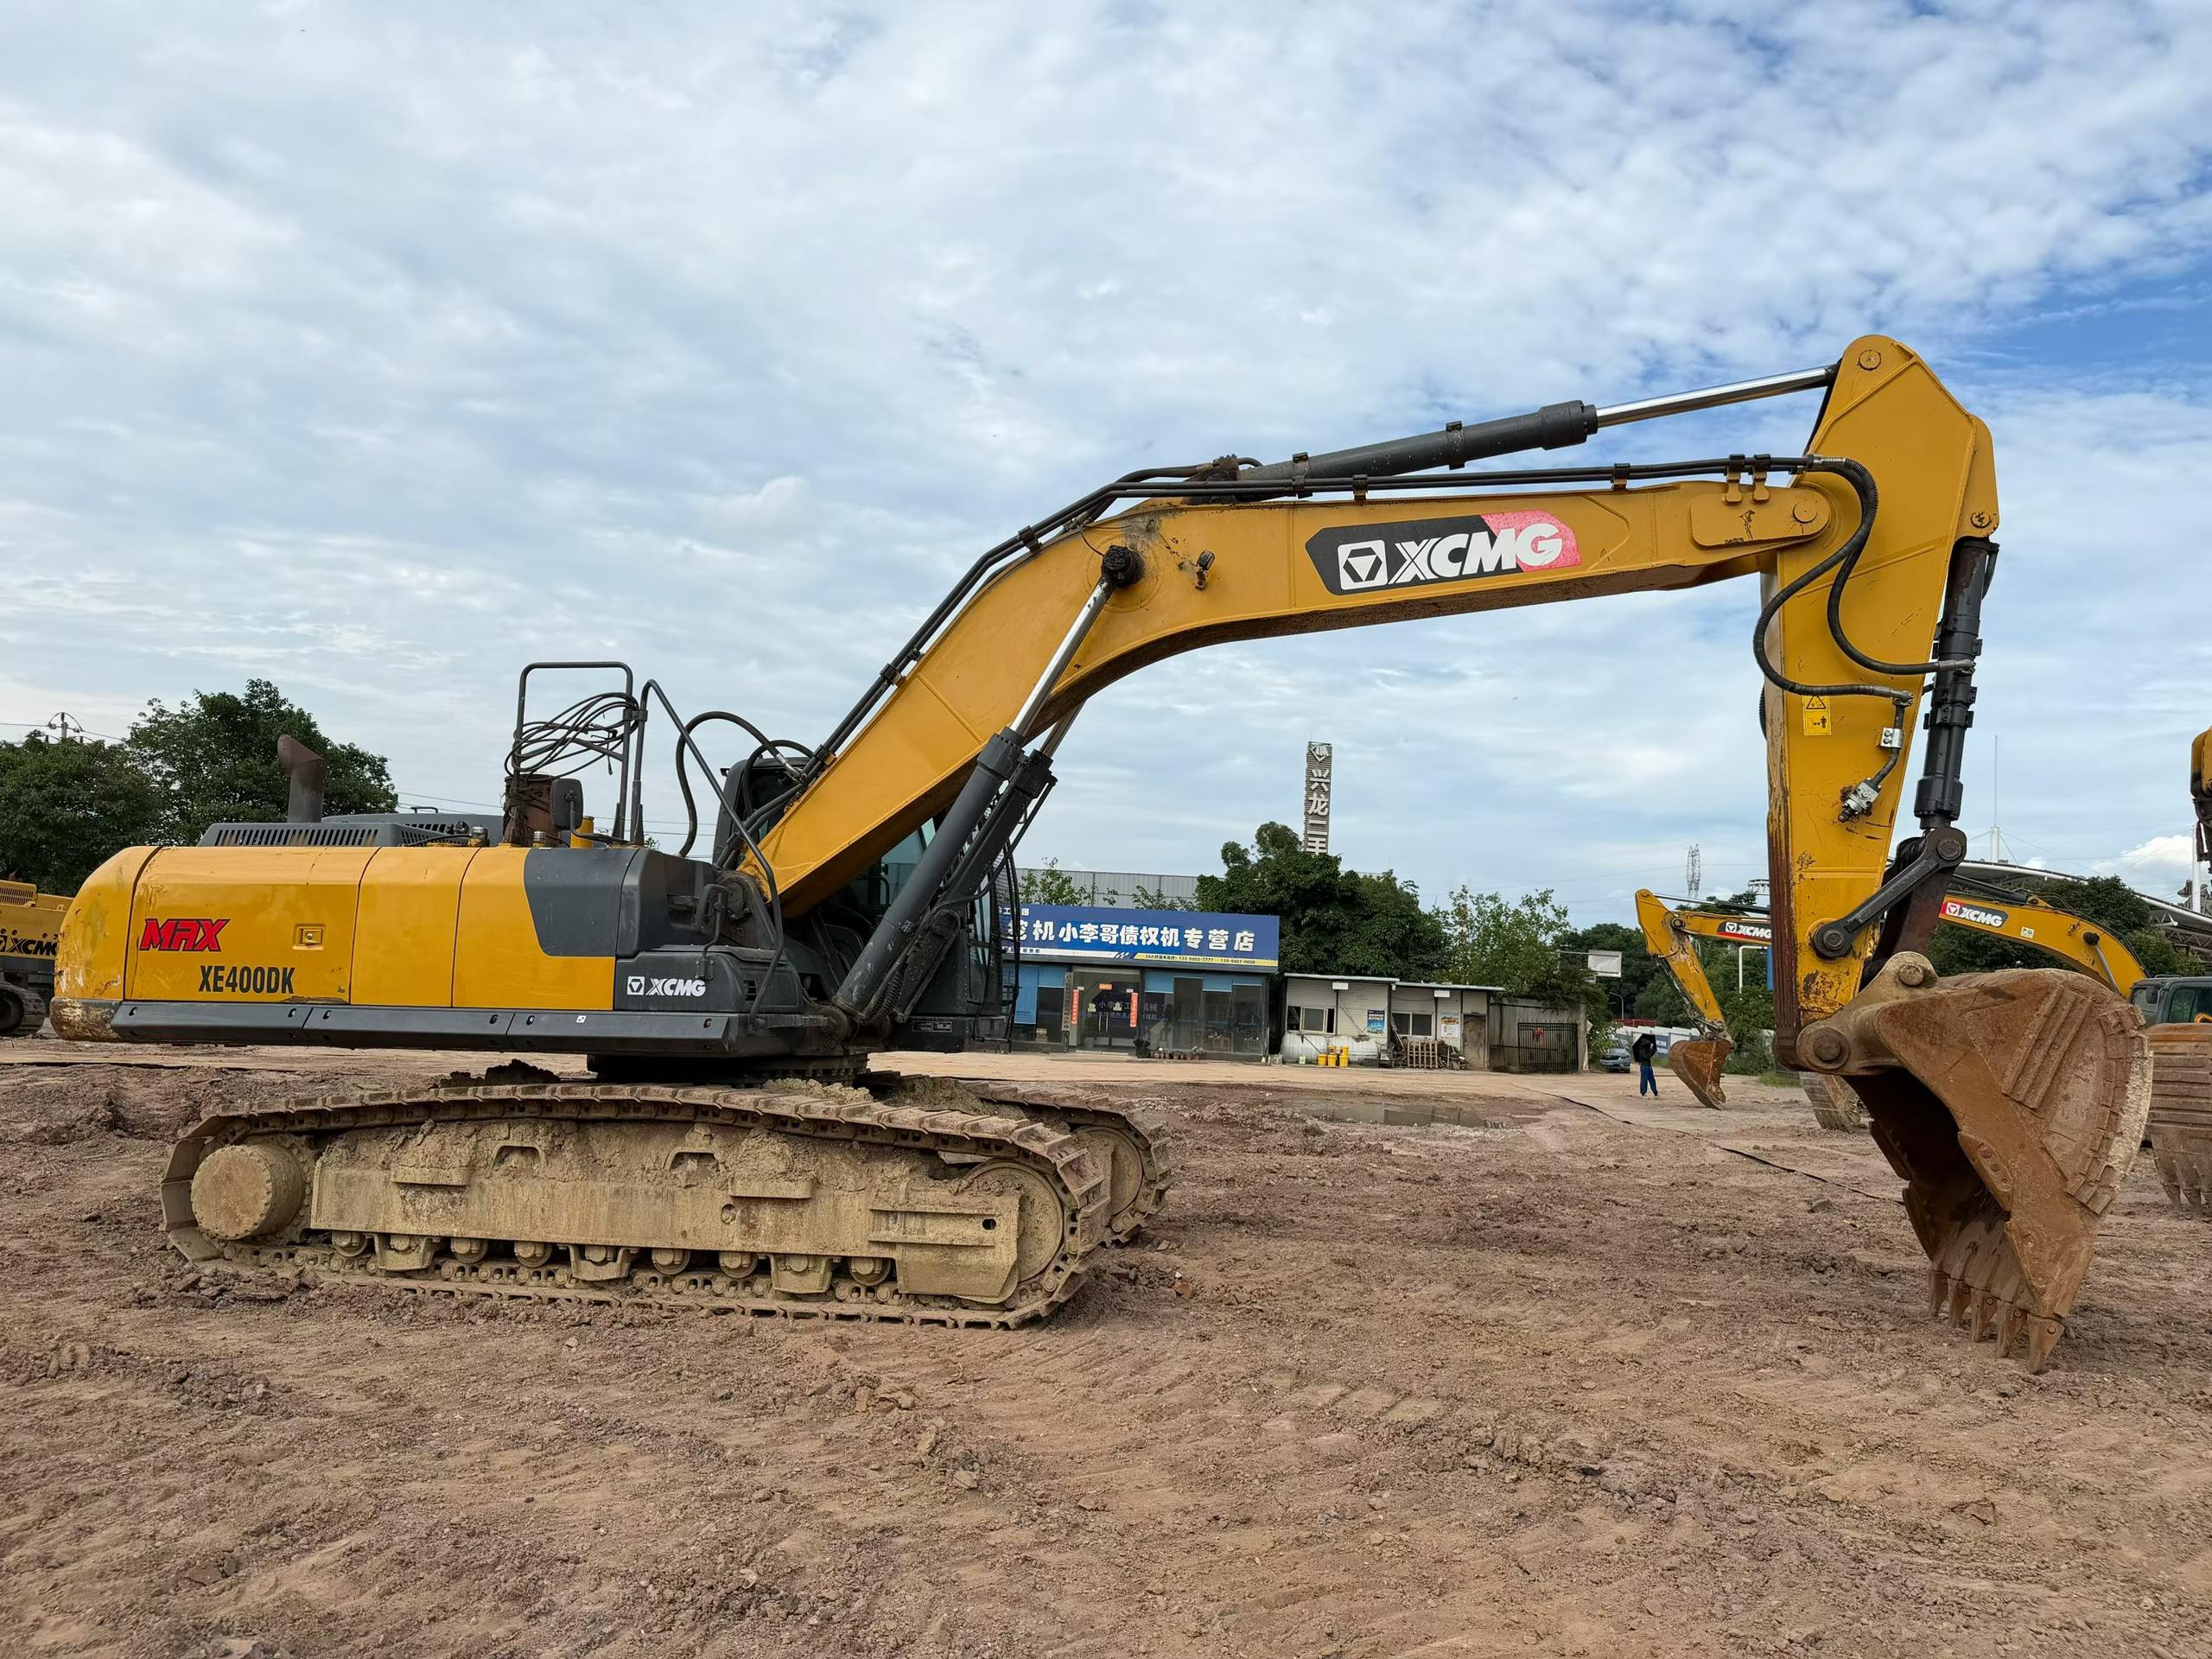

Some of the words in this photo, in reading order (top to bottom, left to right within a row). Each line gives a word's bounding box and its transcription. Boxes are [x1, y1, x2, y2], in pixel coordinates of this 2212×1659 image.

[1388, 523, 1562, 585] XCMG
[1959, 906, 2003, 927] XCMG
[140, 918, 231, 952] MAX
[1736, 925, 1771, 939] XCMG
[199, 965, 296, 994] XE400DK
[645, 978, 706, 996] XCMG
